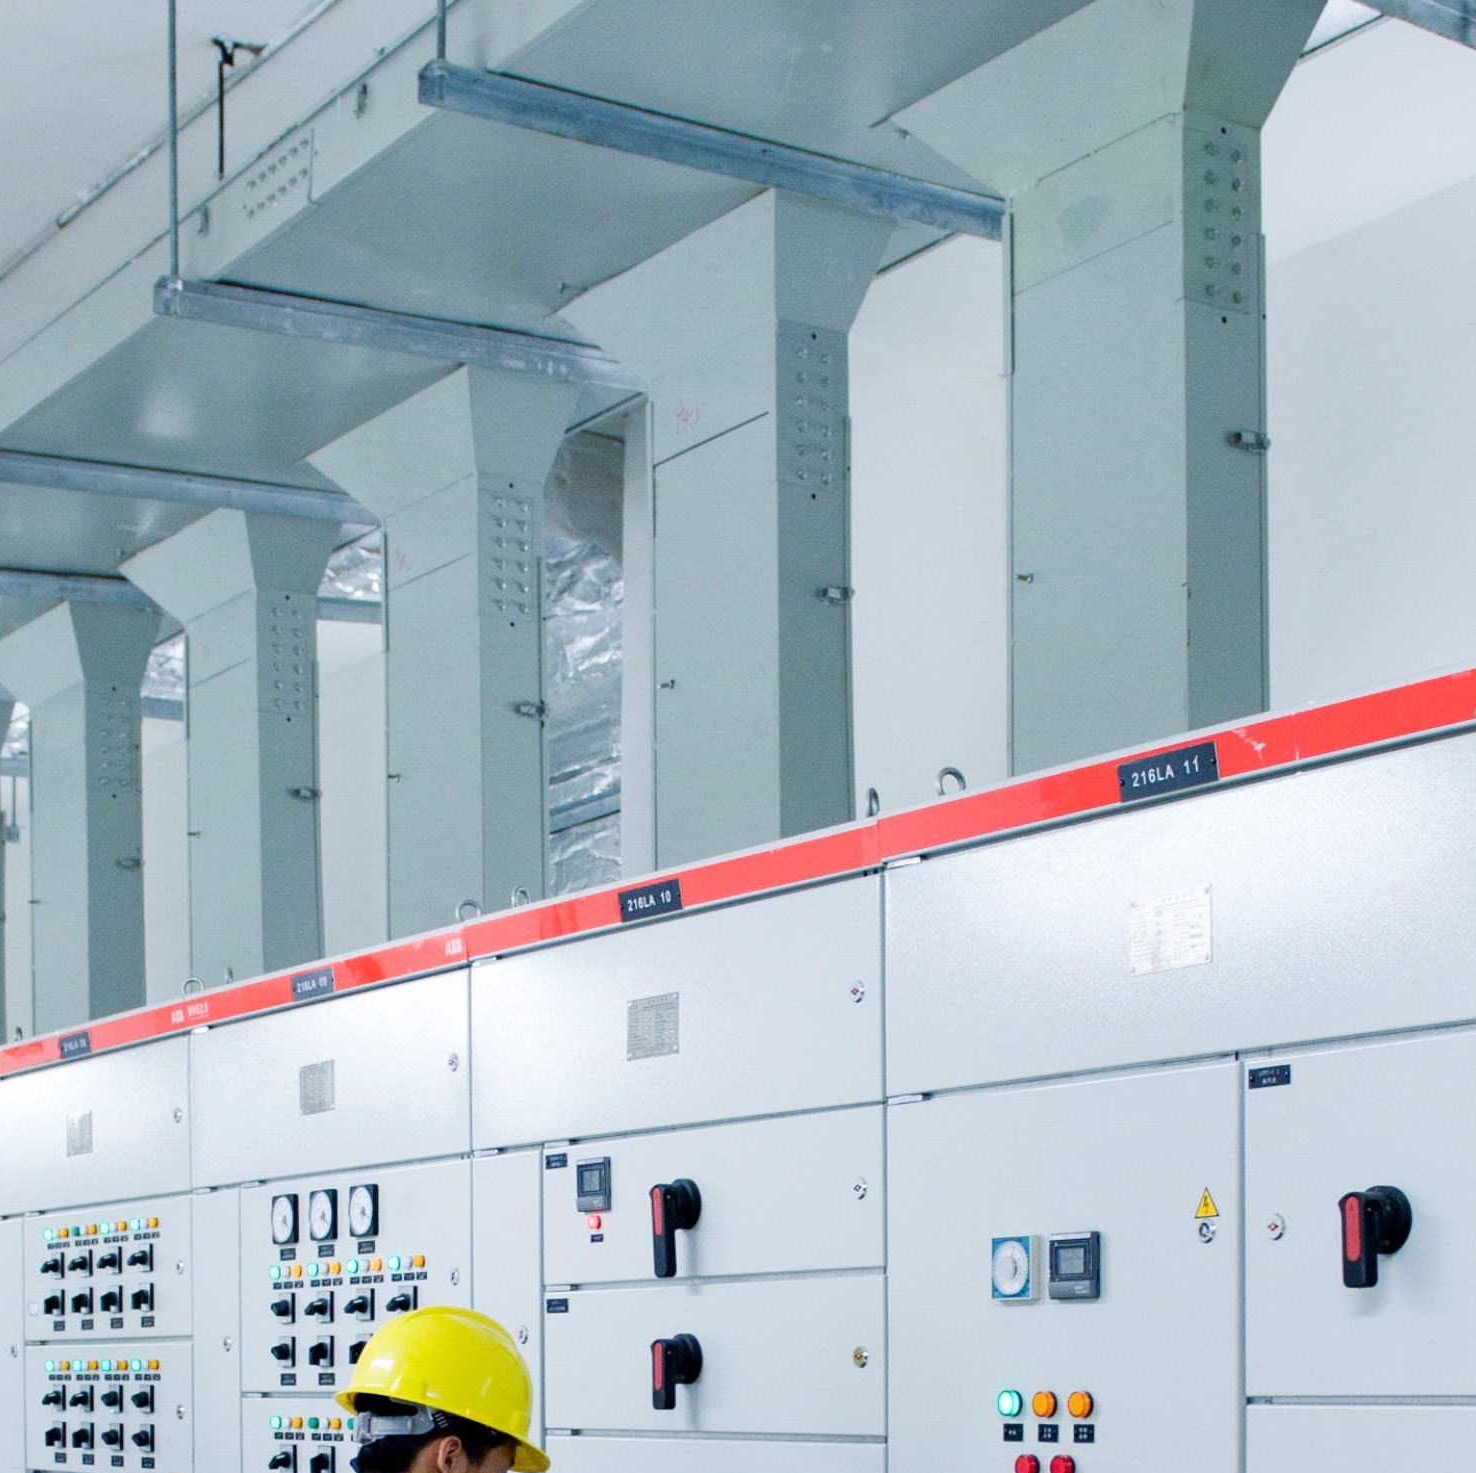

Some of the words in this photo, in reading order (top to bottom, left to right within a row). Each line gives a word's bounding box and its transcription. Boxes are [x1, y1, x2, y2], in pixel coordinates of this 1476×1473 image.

[1131, 763, 1175, 788] 216LA
[1183, 754, 1199, 775] 11
[627, 893, 657, 912] 216LA
[660, 889, 672, 904] 10
